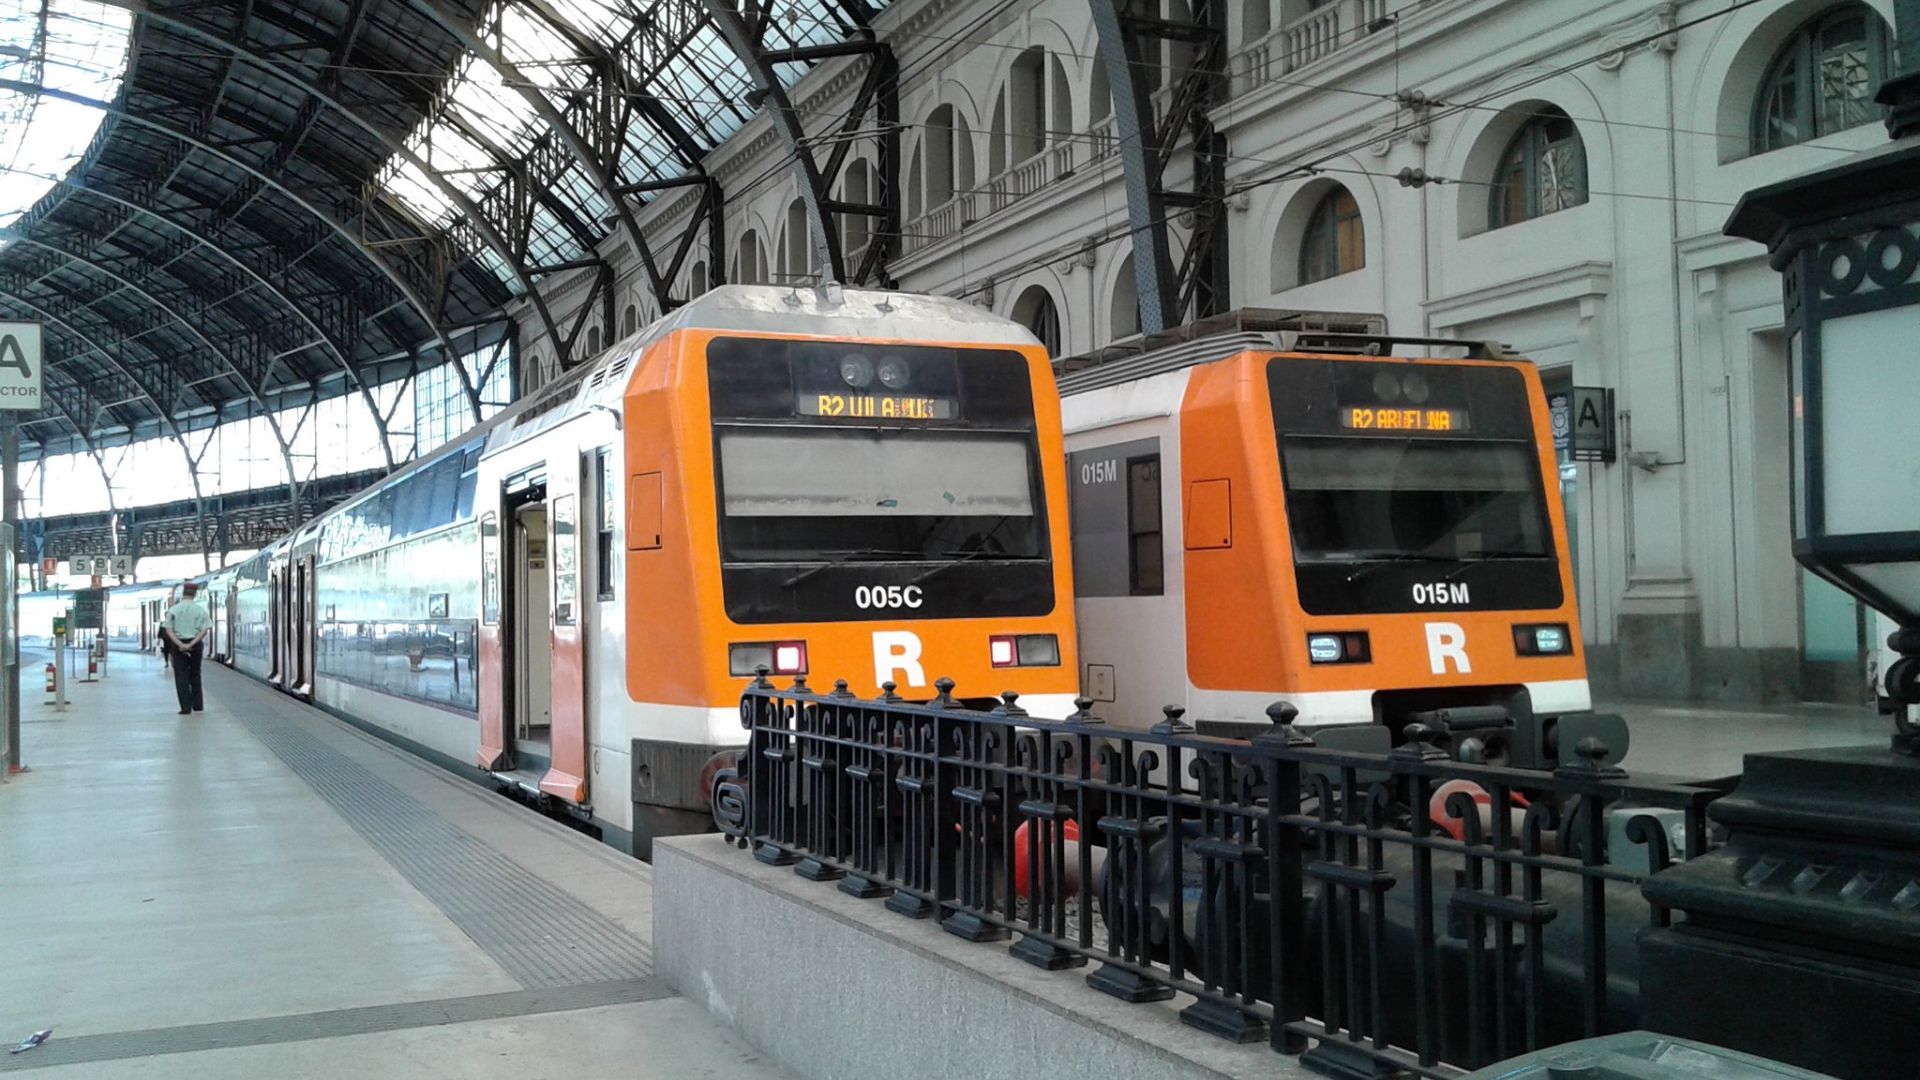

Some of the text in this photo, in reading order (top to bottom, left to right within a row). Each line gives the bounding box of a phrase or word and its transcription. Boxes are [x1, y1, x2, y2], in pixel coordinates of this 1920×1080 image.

[0, 334, 32, 378] A
[818, 395, 844, 416] R2
[1578, 397, 1599, 428] A
[1352, 409, 1373, 428] R2
[1081, 459, 1117, 485] 015M
[76, 560, 85, 571] 5
[116, 559, 126, 571] 4
[855, 585, 922, 608] 005C
[1412, 582, 1469, 604] 015M
[872, 630, 927, 688] R
[1424, 622, 1472, 675] R
